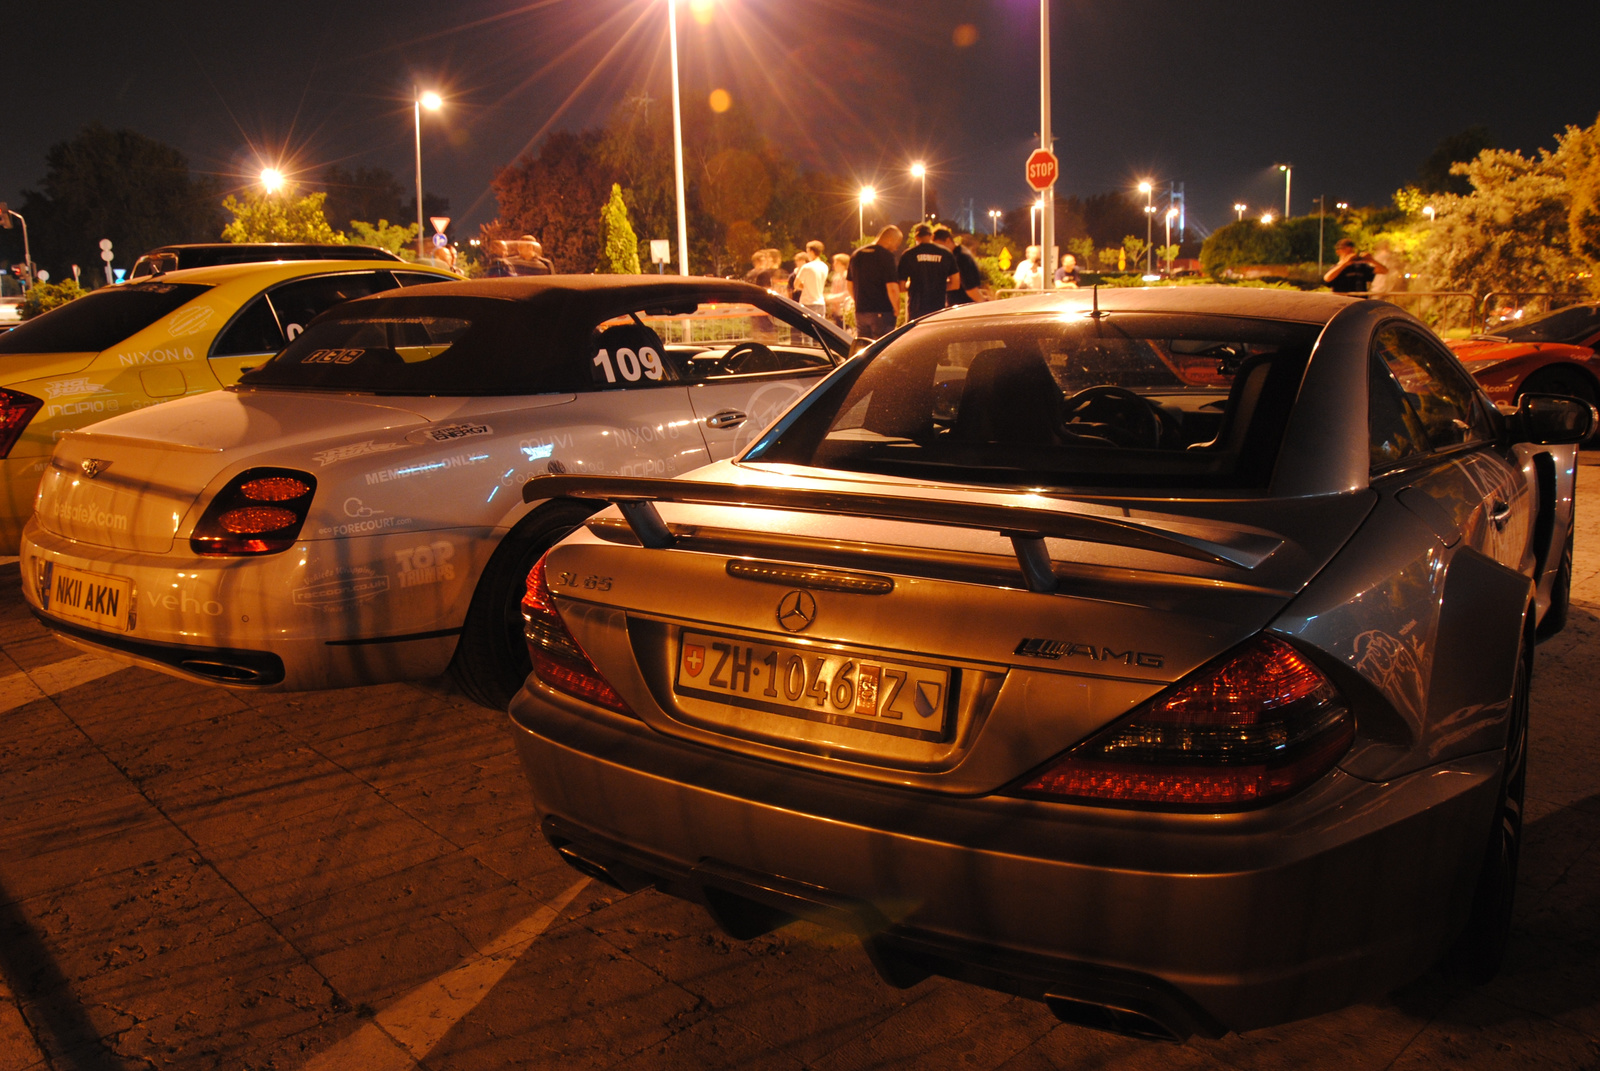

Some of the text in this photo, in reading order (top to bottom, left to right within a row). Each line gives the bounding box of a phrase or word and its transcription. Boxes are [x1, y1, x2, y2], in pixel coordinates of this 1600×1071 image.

[1029, 161, 1054, 179] STOP
[118, 348, 180, 366] NIXON
[593, 346, 663, 383] 109
[48, 400, 104, 416] INCIPIO
[613, 426, 665, 447] NIXON
[395, 542, 455, 571] TOP
[556, 572, 613, 591] SL 65
[56, 575, 120, 617] NK11 AKN
[147, 590, 223, 617] veho
[1067, 643, 1165, 669] AMG
